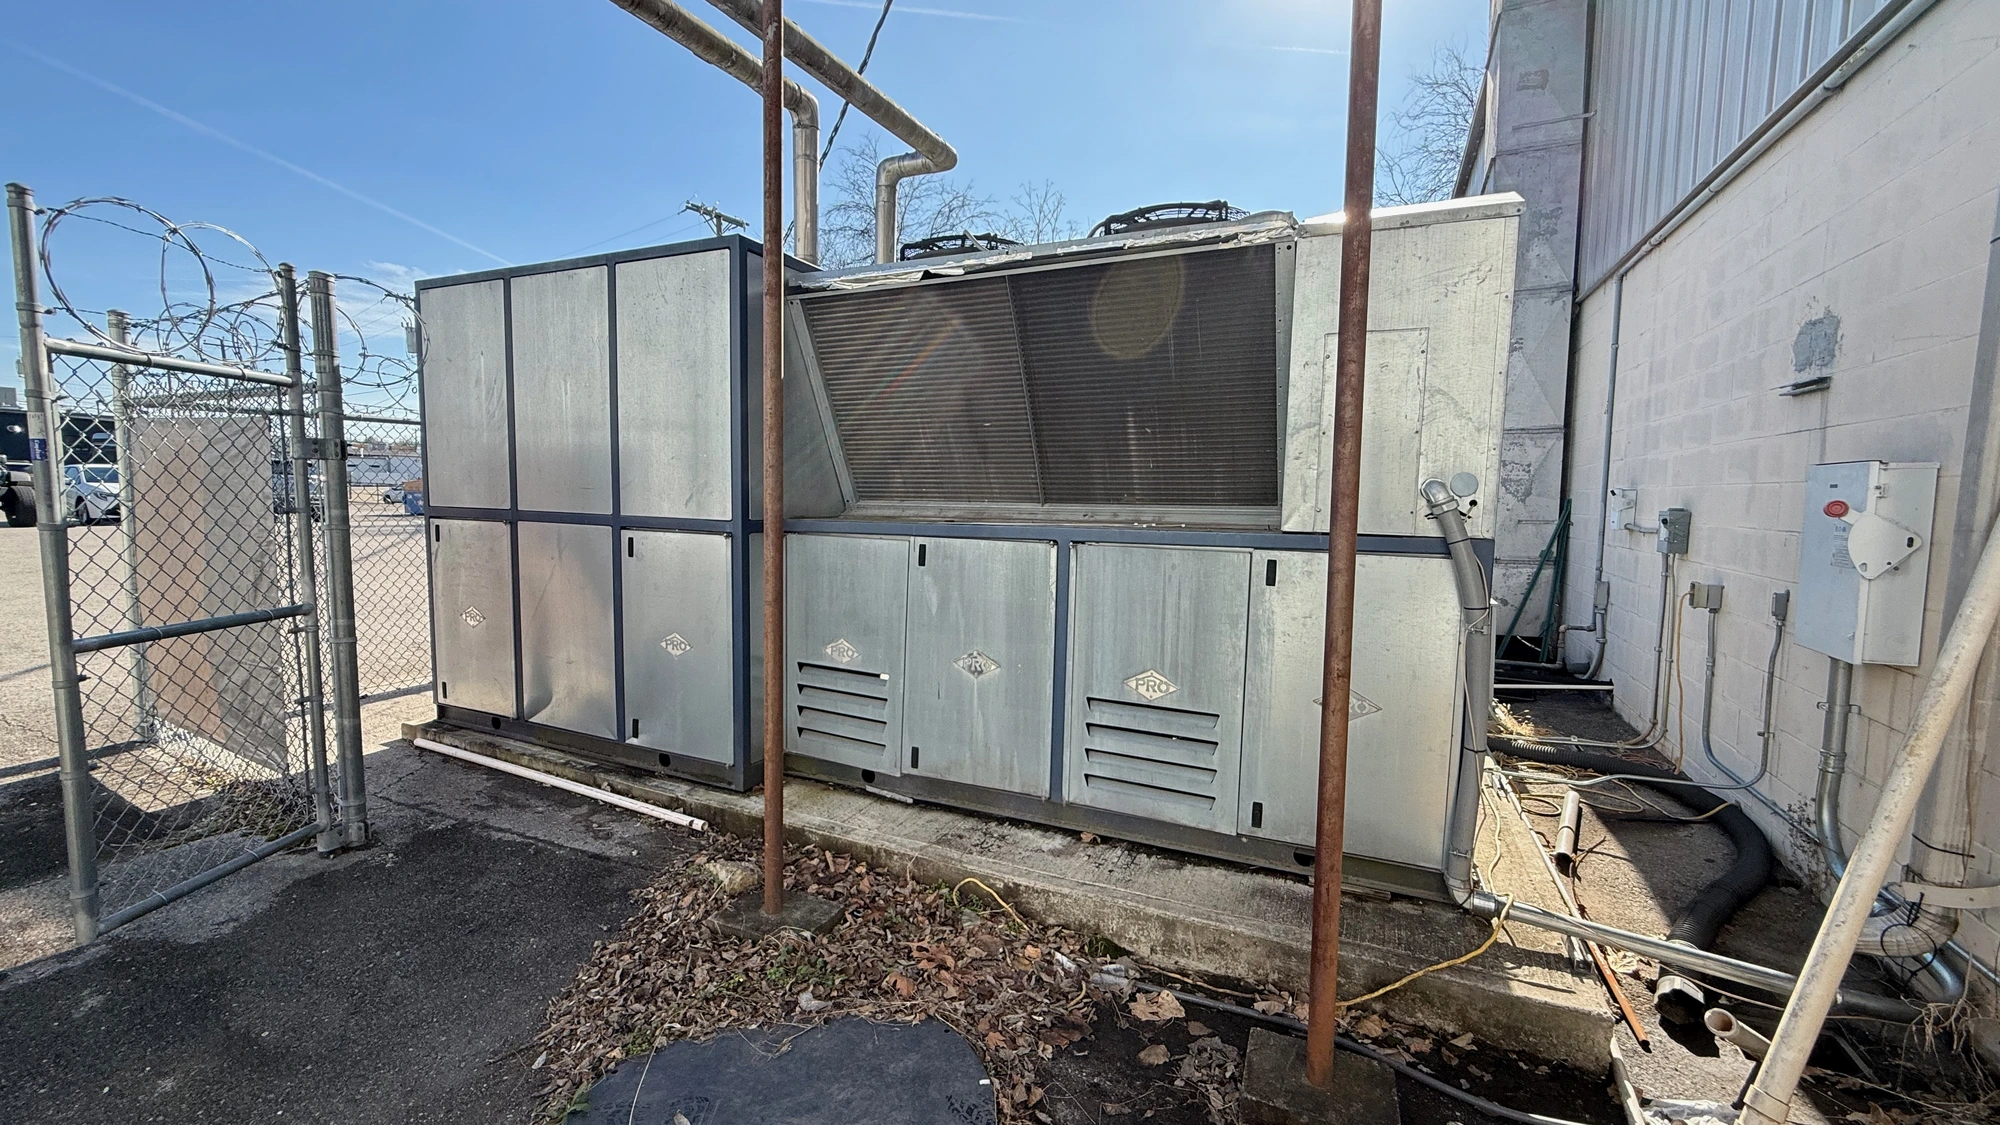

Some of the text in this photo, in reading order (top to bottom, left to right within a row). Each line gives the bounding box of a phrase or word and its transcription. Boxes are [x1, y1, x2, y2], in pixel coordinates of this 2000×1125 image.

[465, 611, 481, 622] PRO
[665, 639, 688, 651] PRO
[830, 646, 854, 658] PRO
[962, 657, 992, 672] PRO
[1135, 678, 1170, 693] PRO
